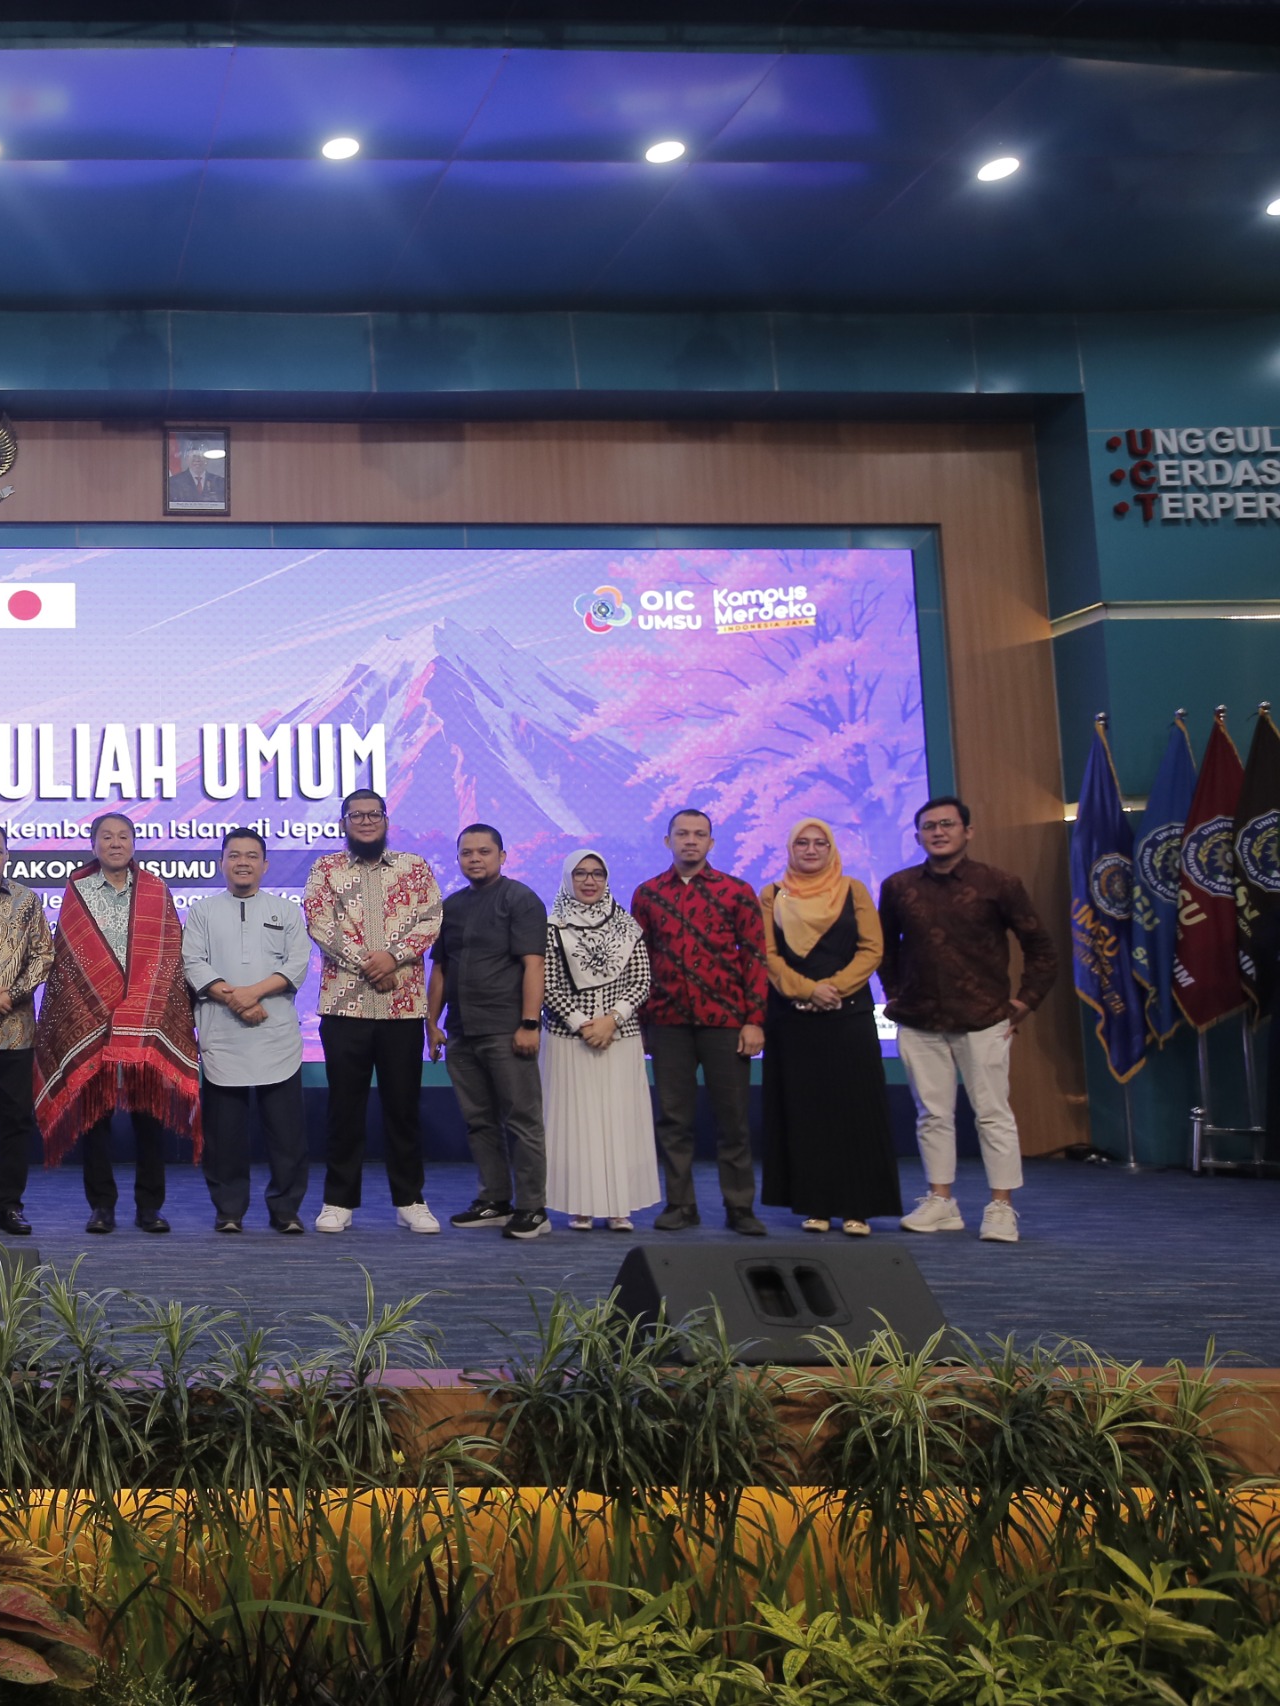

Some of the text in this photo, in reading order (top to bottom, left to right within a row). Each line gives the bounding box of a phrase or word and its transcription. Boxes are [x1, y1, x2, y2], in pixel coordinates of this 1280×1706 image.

[1126, 427, 1280, 456] UNGGUL
[1131, 459, 1280, 487] CERDAS
[639, 590, 696, 611] OIC
[713, 585, 808, 608] Kampus
[638, 614, 702, 630] UMSU
[714, 602, 817, 625] Merdeka
[202, 722, 387, 799] UMUM
[276, 821, 346, 844] Jepa
[3, 861, 216, 878] TAKON SUMU
